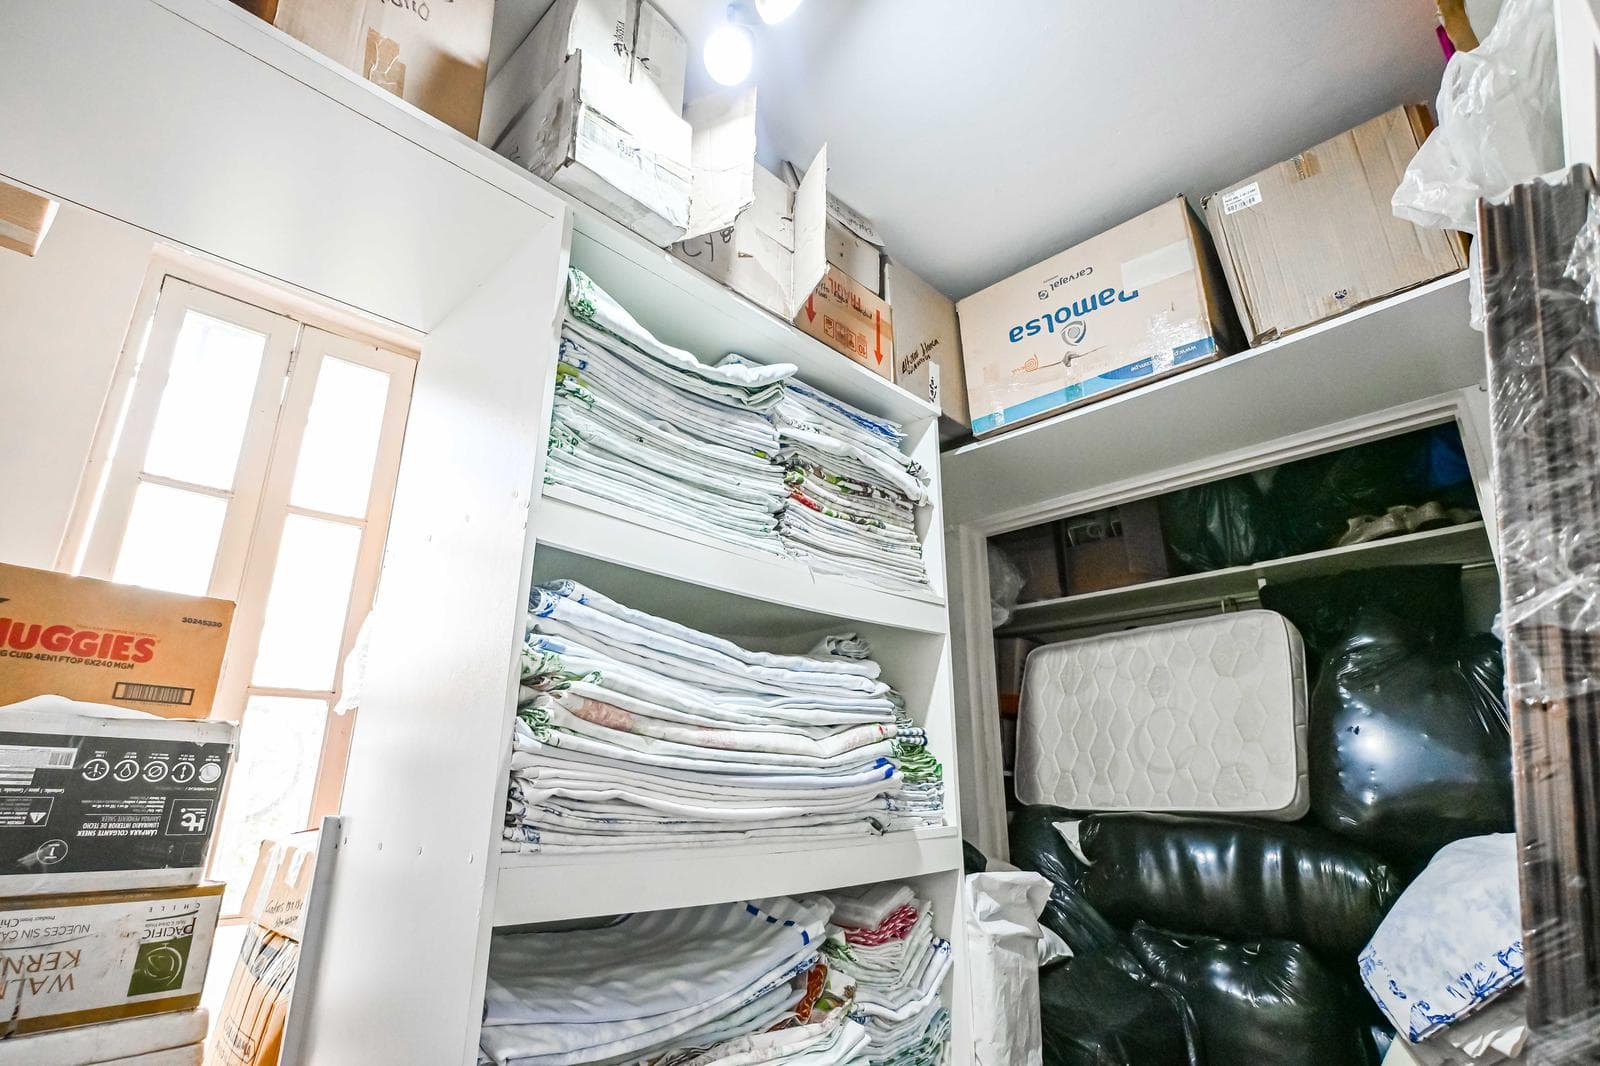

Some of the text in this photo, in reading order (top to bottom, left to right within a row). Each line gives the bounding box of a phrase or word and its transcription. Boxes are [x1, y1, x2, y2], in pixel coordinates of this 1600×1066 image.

[1050, 266, 1093, 292] Carvajal
[9, 650, 33, 660] CUID
[113, 662, 135, 671] MGM
[0, 923, 91, 941] NUECES SIN CA
[142, 916, 197, 940] PACIFIC
[0, 949, 82, 975] KERN
